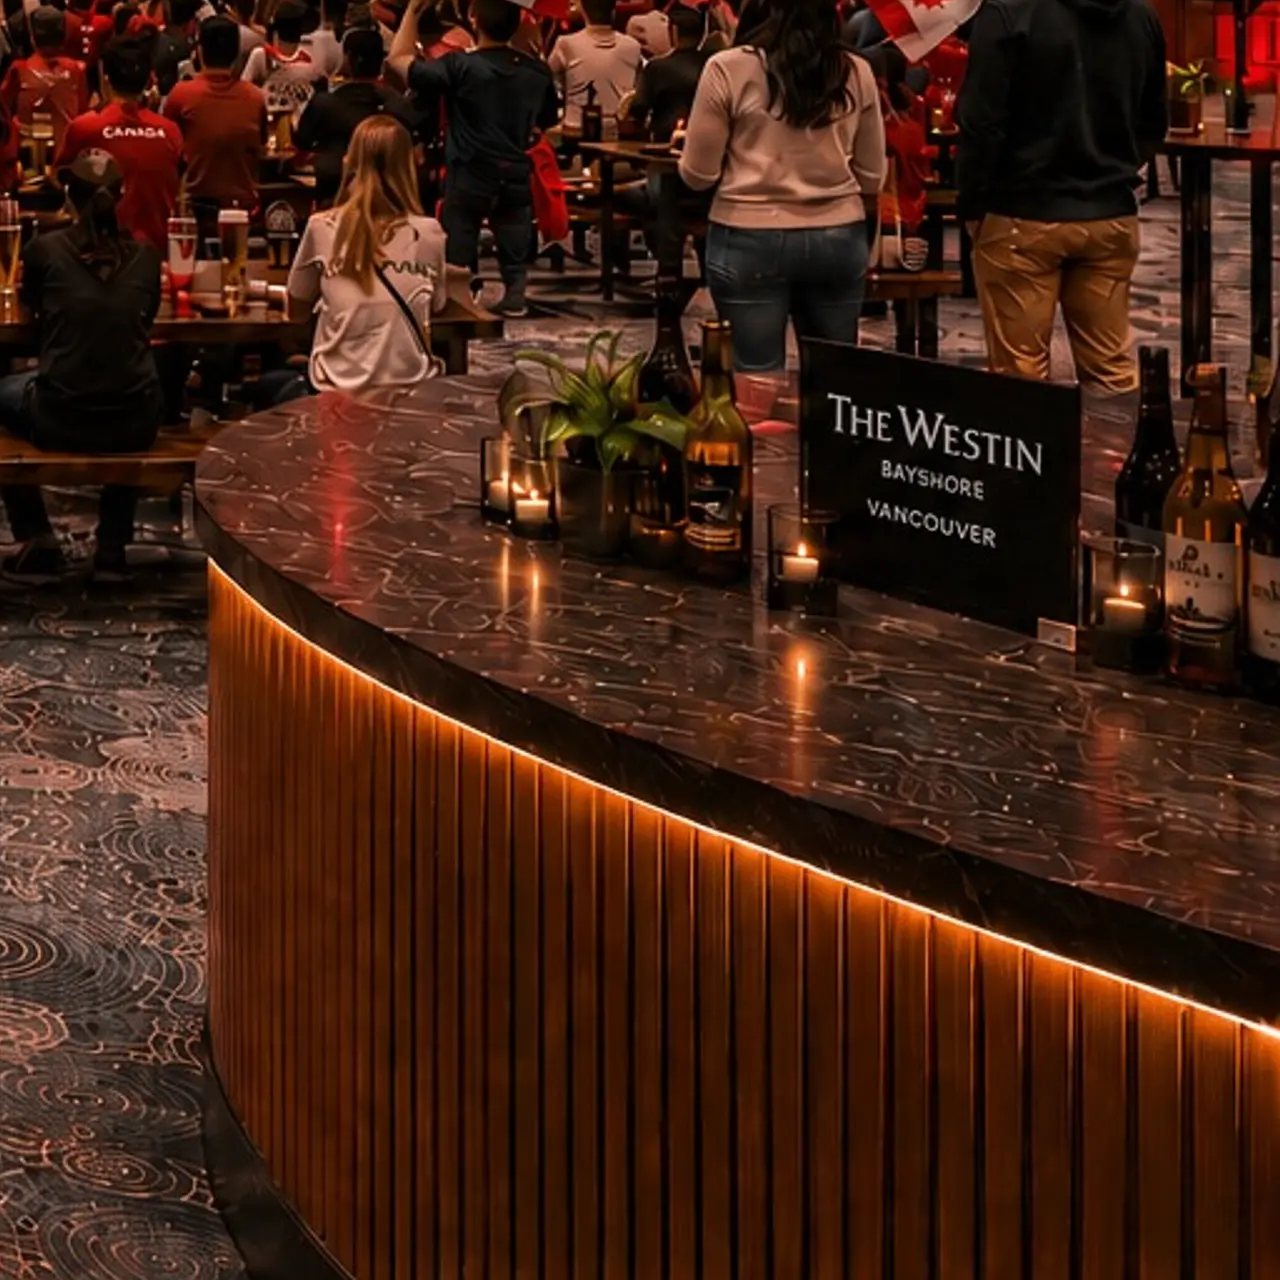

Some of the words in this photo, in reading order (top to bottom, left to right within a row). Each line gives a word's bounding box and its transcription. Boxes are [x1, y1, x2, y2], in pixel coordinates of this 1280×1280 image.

[826, 392, 894, 442] THE
[896, 404, 1044, 476] WESTIN
[880, 458, 985, 501] BAYSHORE
[865, 497, 997, 548] VANCOUVER
